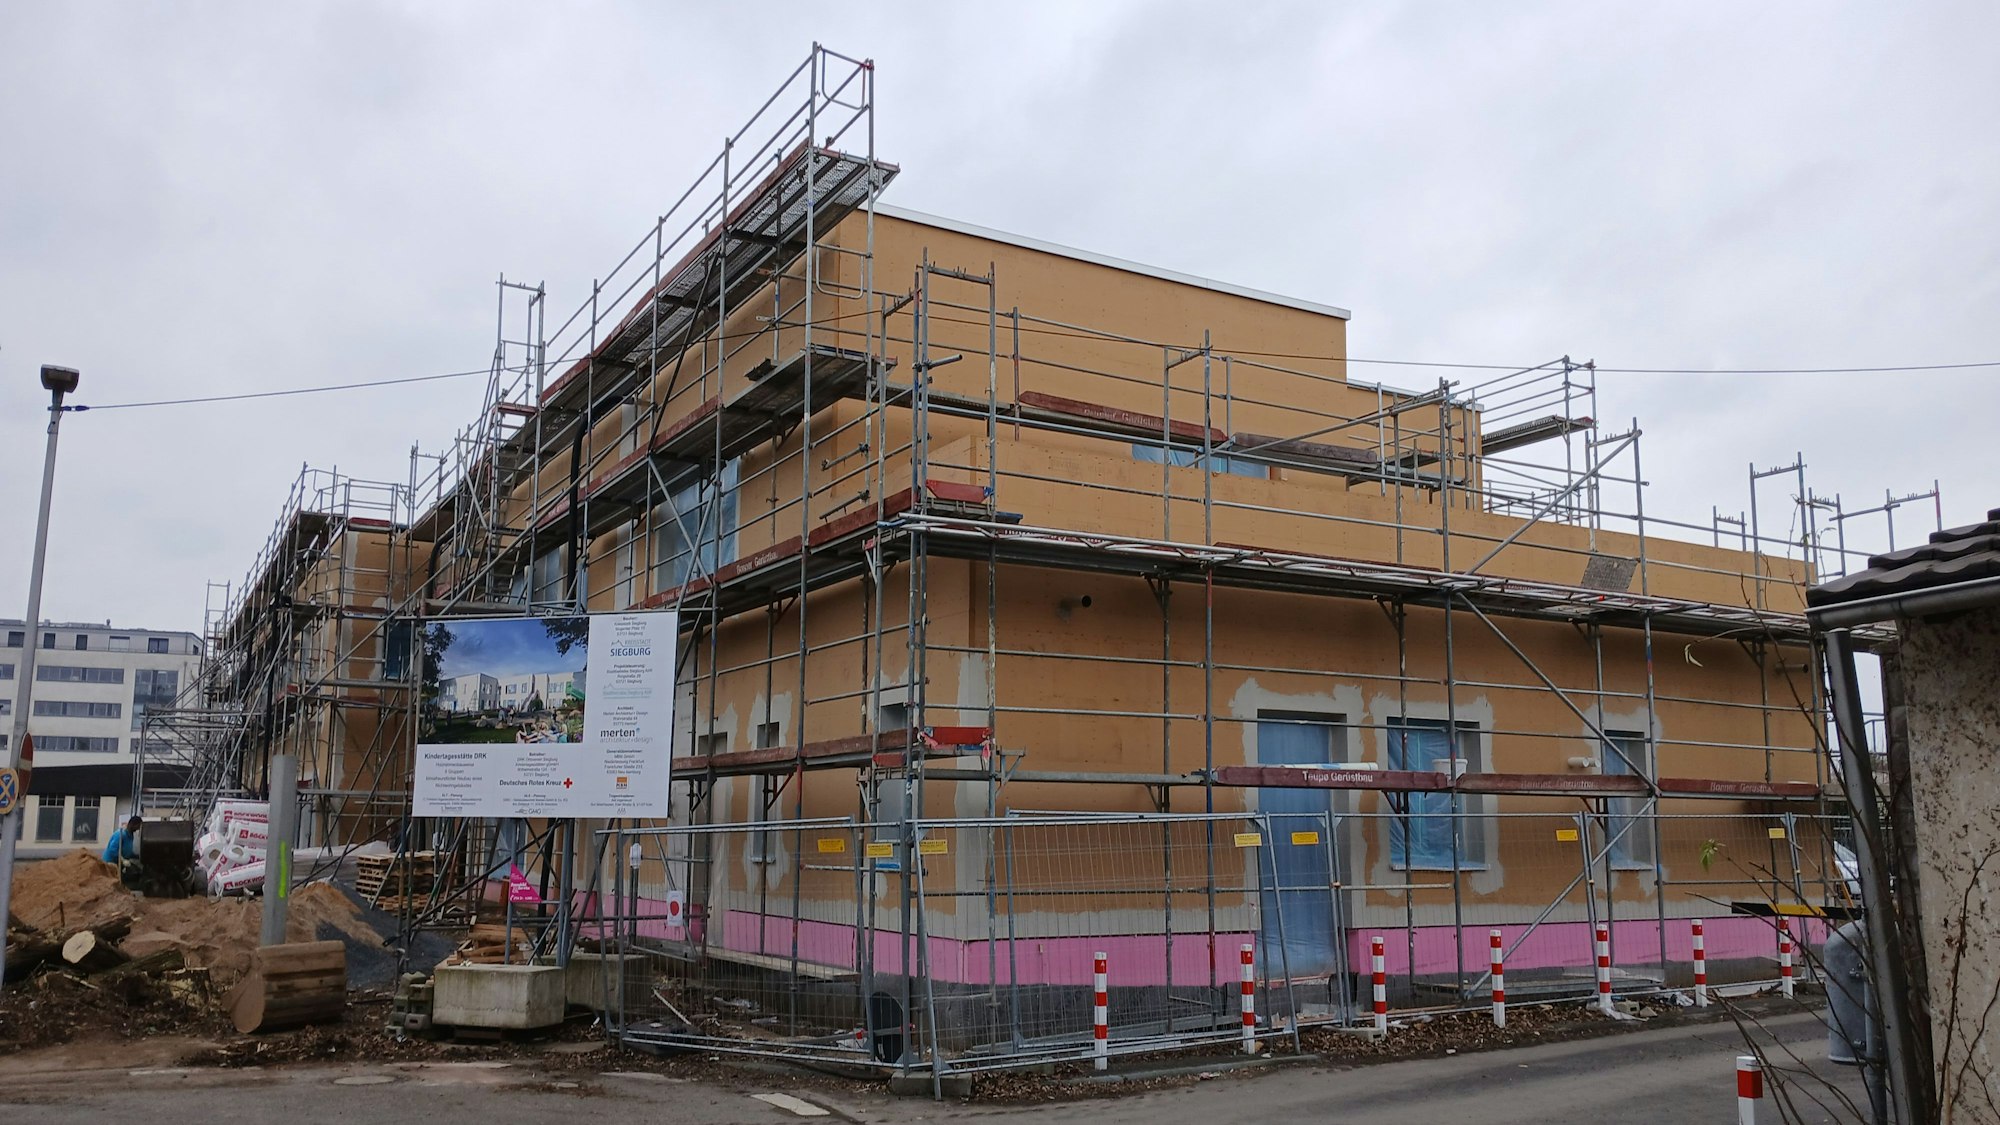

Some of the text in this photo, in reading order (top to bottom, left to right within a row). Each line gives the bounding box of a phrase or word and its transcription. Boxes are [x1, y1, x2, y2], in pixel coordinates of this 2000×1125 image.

[610, 647, 651, 657] SIEGBURG
[600, 728, 636, 738] merten
[1330, 772, 1373, 782] Gerüstbau
